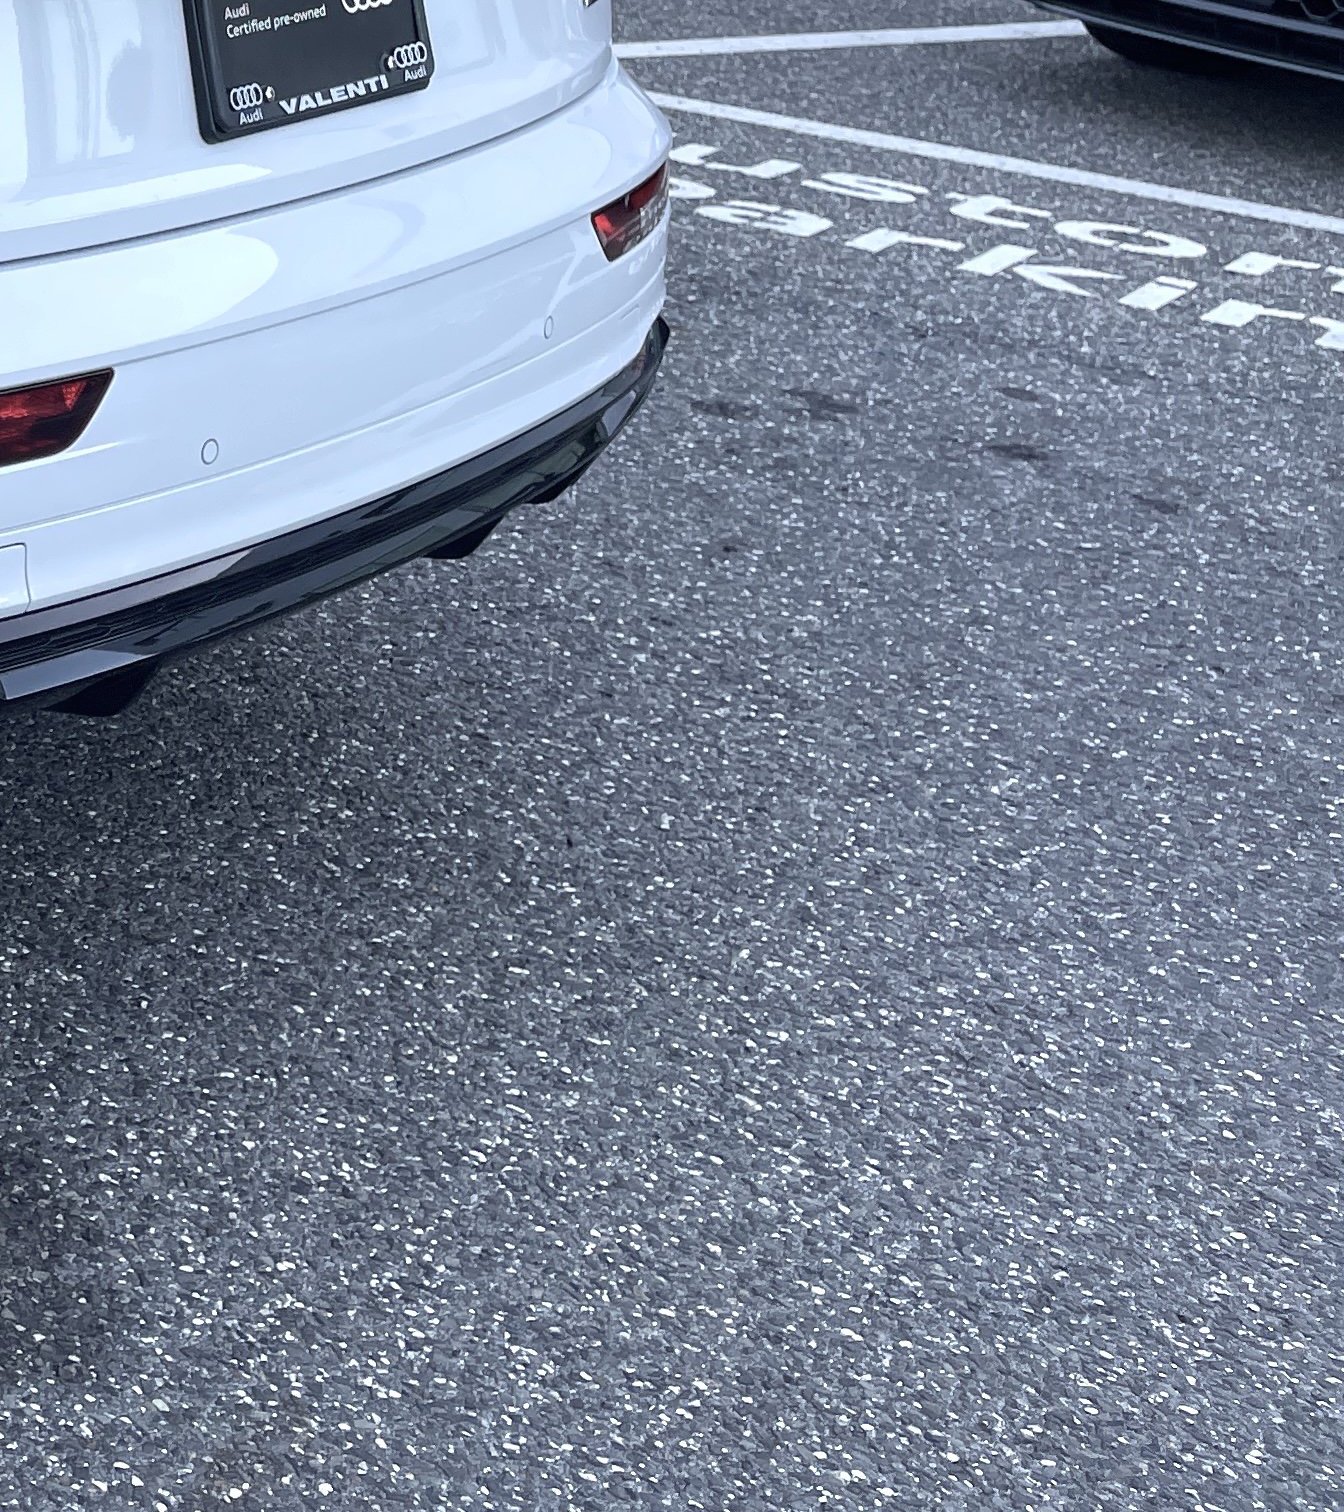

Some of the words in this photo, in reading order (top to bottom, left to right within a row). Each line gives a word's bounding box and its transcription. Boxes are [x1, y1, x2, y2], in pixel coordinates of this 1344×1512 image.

[224, 3, 250, 20] Audi
[226, 17, 272, 39] Certified
[273, 4, 327, 31] pre-owned
[404, 66, 427, 82] Audi
[278, 74, 390, 115] VALENTI
[239, 109, 264, 125] Audi
